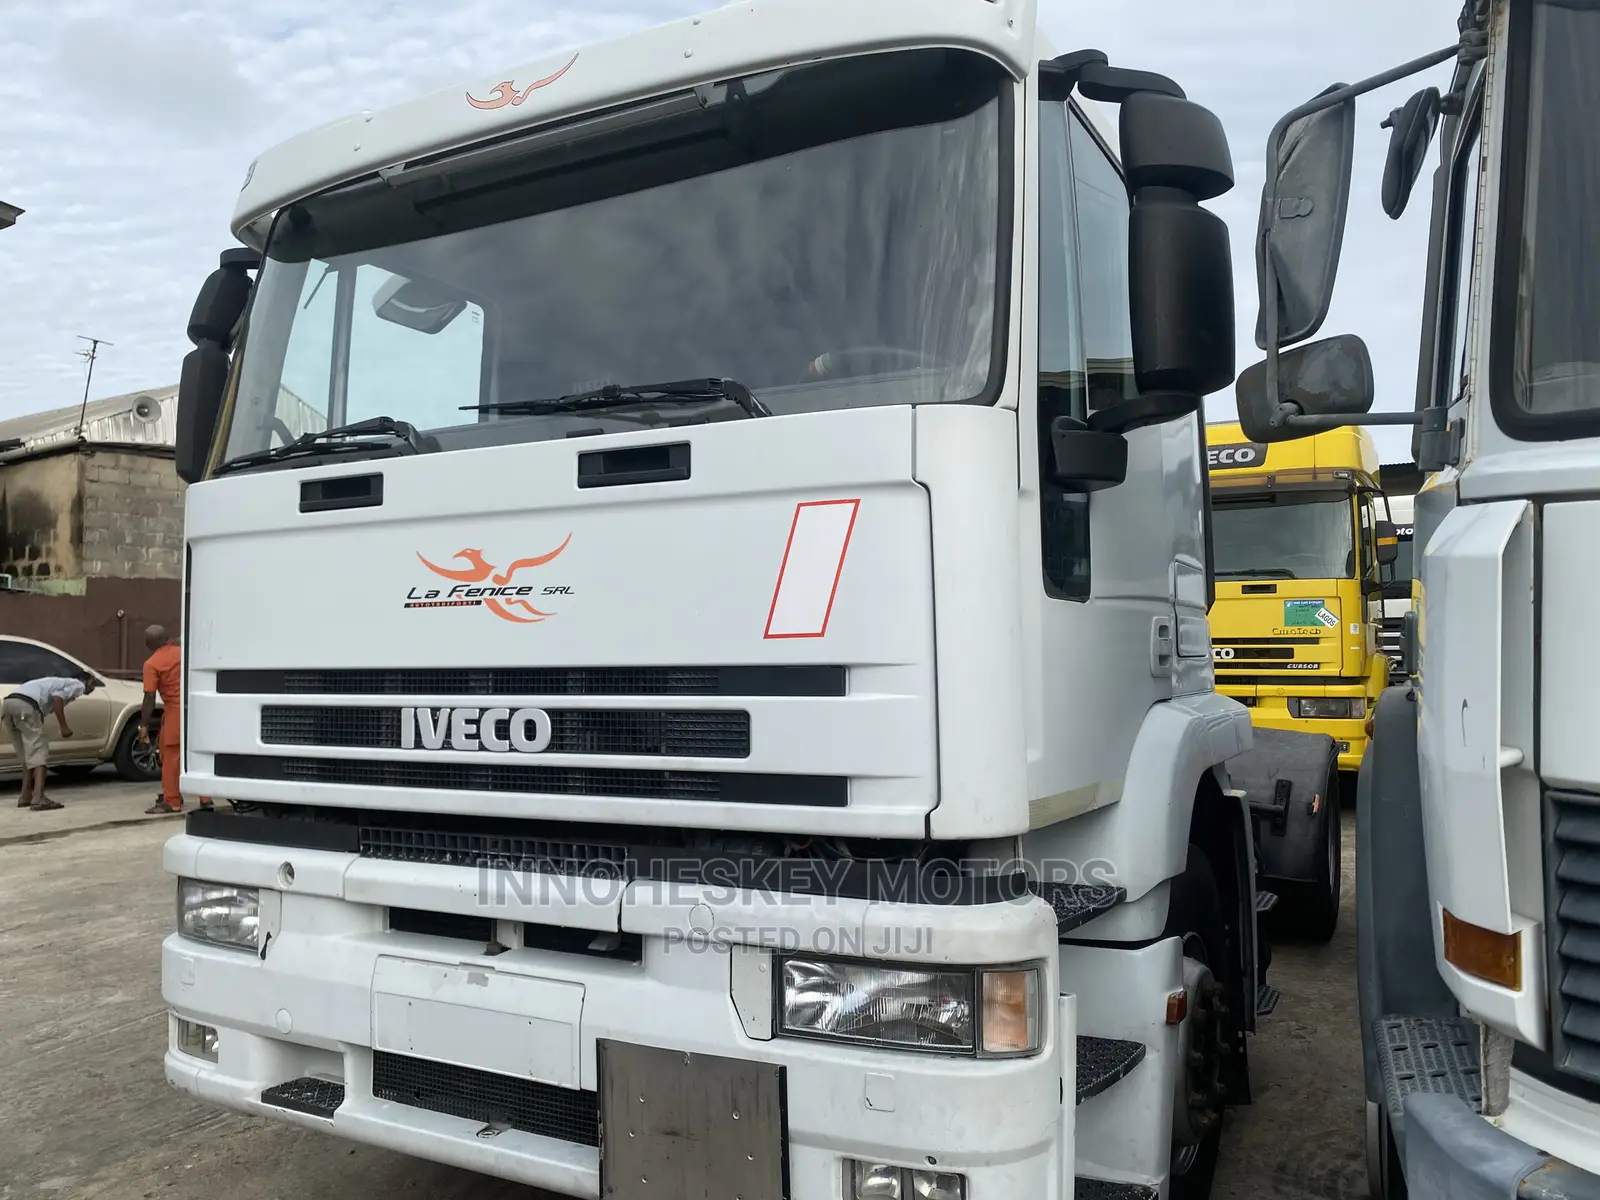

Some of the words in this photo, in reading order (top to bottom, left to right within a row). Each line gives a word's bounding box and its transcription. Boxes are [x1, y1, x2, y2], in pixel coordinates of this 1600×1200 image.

[1207, 448, 1256, 465] ECO
[406, 587, 441, 600] La
[447, 584, 534, 599] Fenice
[540, 586, 575, 596] SRL
[1317, 610, 1336, 627] LAGOS
[401, 707, 552, 753] IVECO
